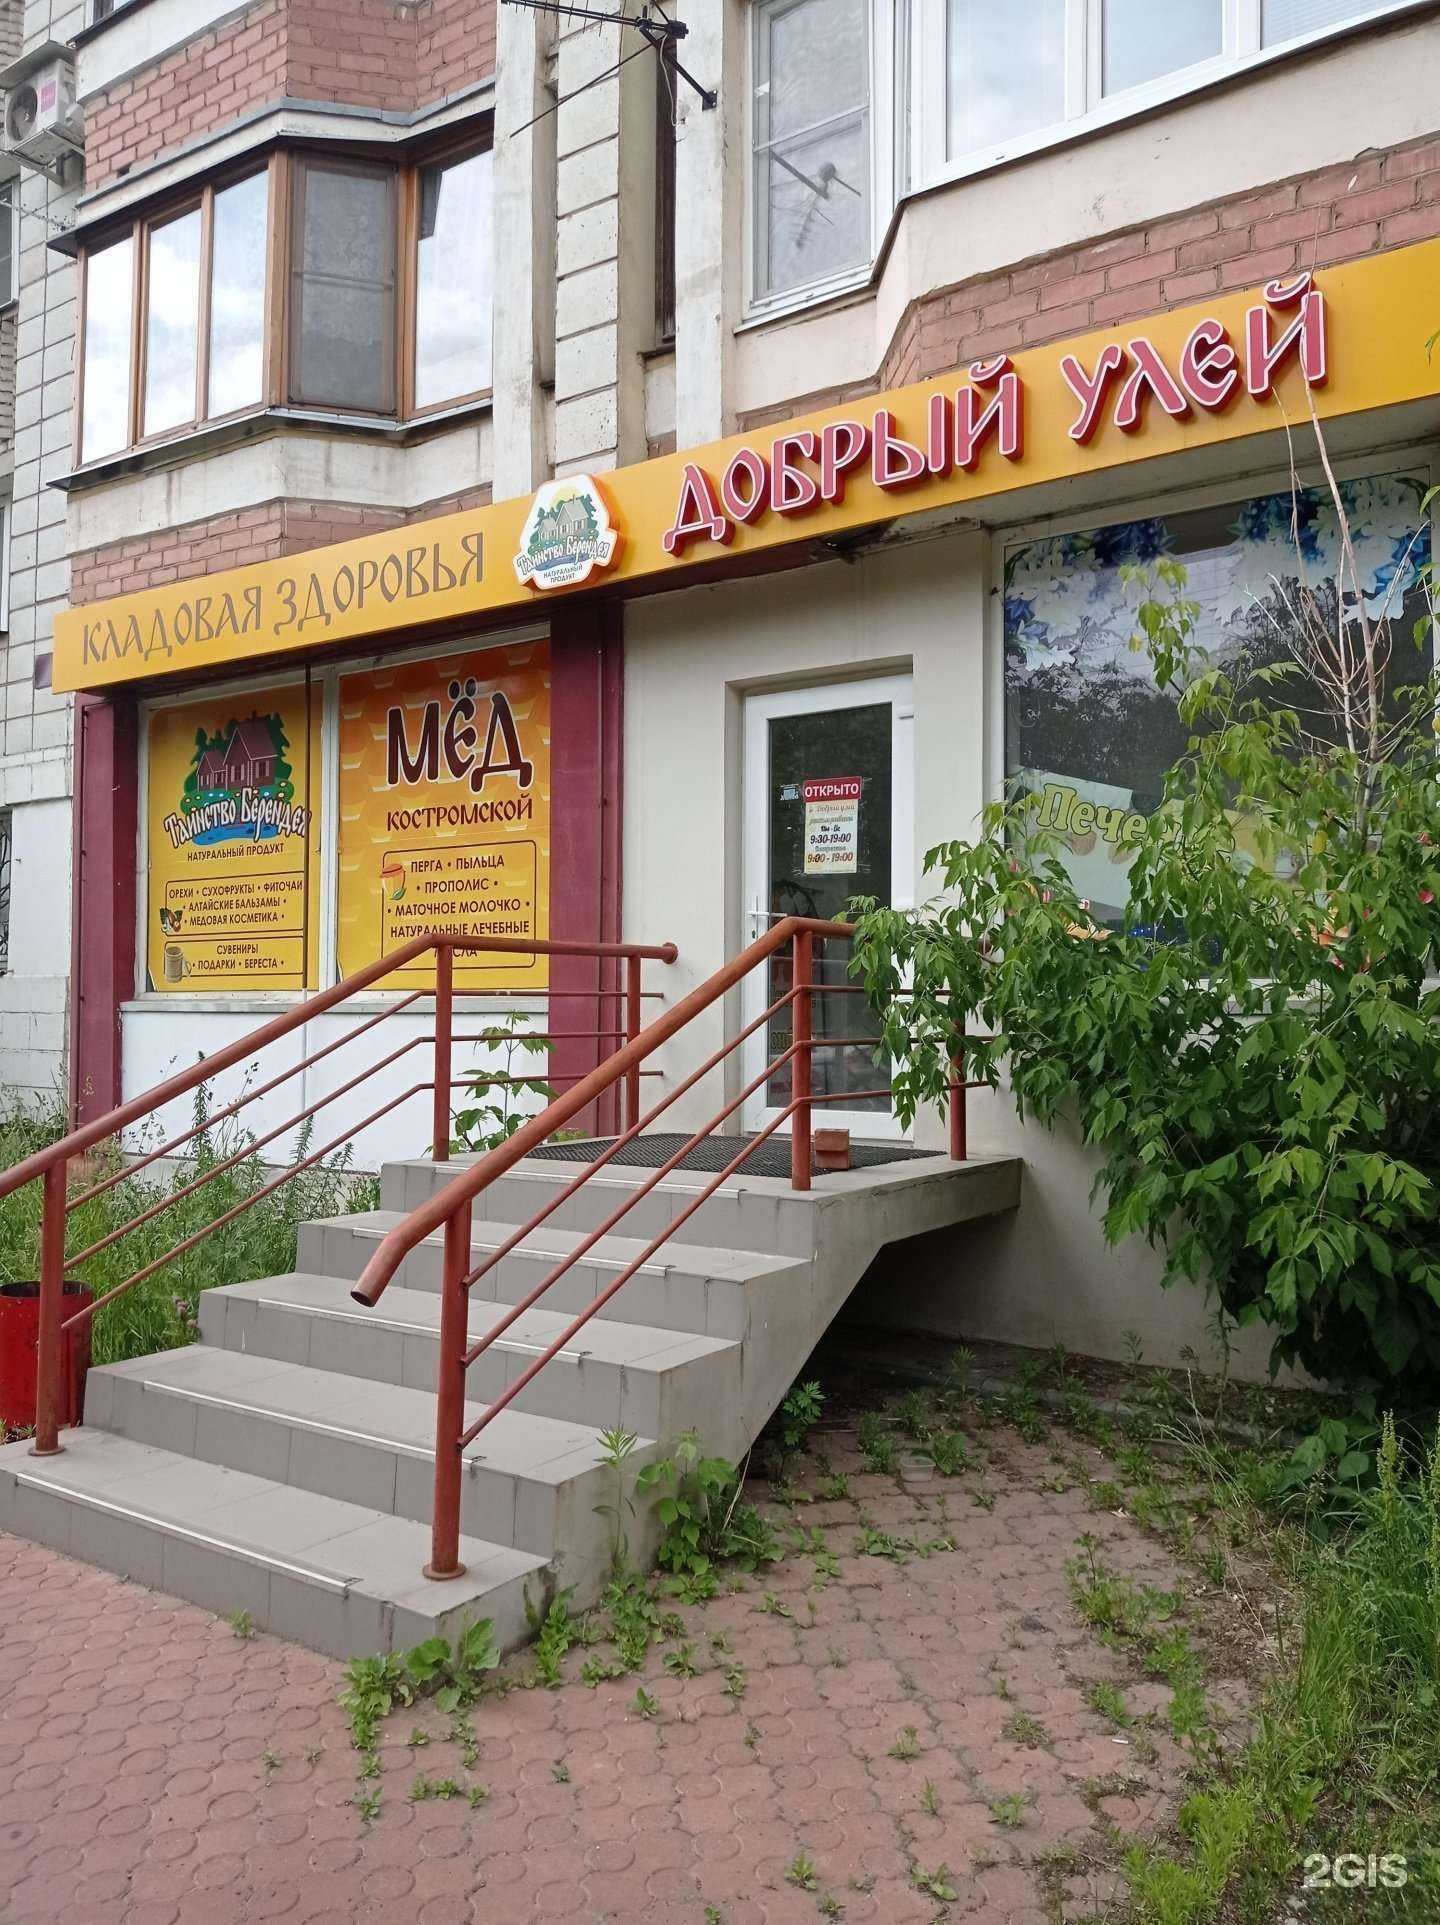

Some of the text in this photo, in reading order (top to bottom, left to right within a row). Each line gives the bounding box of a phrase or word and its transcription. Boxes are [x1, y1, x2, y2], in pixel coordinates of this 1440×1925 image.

[662, 271, 1329, 558] ДОБРЫЙ УЛЕЙ
[550, 573, 575, 583] ПРОДУКТ
[82, 532, 484, 666] КЛАДОВАЯ ЗДОРОВЬЯ
[387, 676, 533, 795] МЁД
[804, 783, 859, 798] ОТКРЫТО
[387, 793, 533, 832] КОСТРОМСКОЙ
[810, 833, 852, 844] 9:30-19:00
[187, 842, 284, 862] НАТУРАЛЬНЫЙ ПРОДУКТ
[411, 854, 505, 873] ПЕРГА ПЫЛЬЦА
[169, 880, 303, 899] ОРЕХИ СУХОФРУКТЫ ФИТОЧАИ
[425, 878, 490, 893] ПРОПОЛИС
[188, 897, 281, 912] АЛТАЙСКИЕ БАЛЬЗАМЫ
[395, 898, 521, 917] МАТОЧНОЕ МОЛОЧКО
[189, 912, 279, 927] МЕДОВАЯ КОСМЕТИКА
[390, 920, 530, 938] НАТУРАЛЬНЫЕ ЛЕЧЕБНЫЕ
[216, 943, 259, 955] СУВЕНИРЫ
[198, 958, 278, 970] ПОДАРКИ БЕРЕСТА
